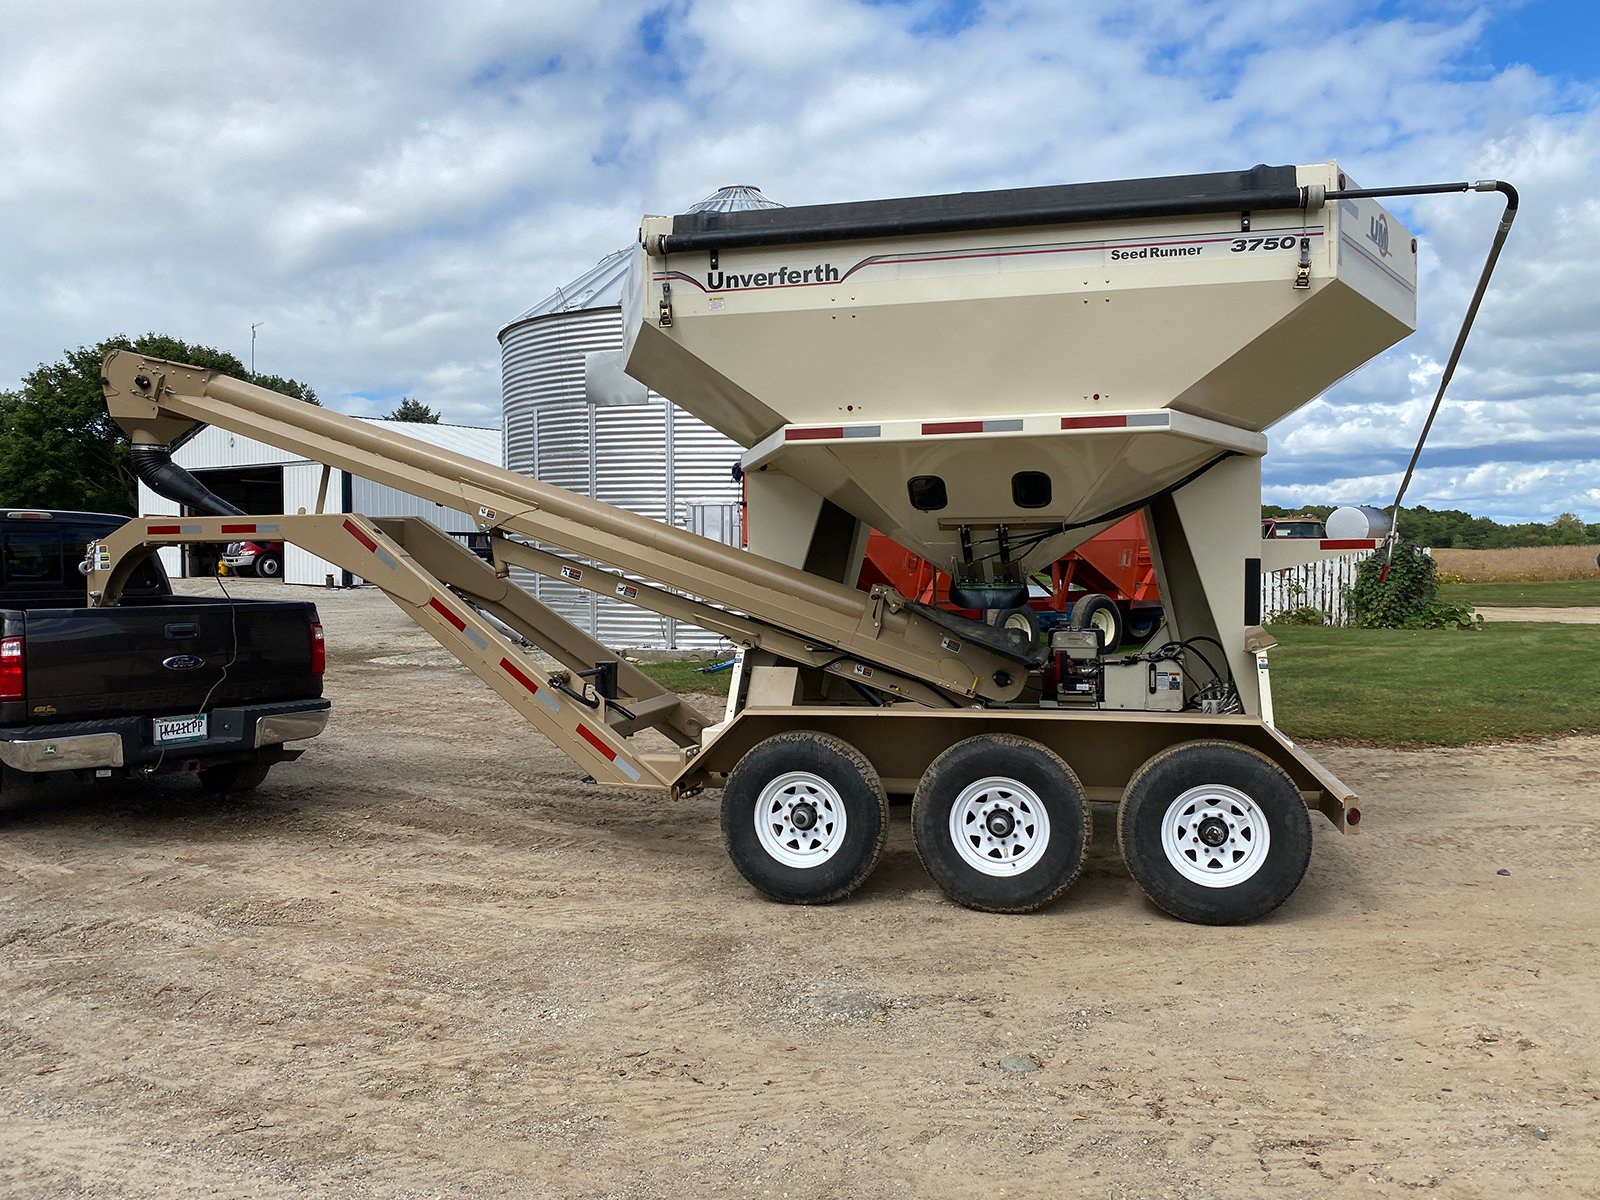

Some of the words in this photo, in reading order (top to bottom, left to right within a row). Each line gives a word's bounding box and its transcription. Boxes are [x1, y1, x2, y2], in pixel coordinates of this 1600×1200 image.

[1111, 248, 1147, 260] Seed
[1150, 245, 1203, 258] Runner
[1230, 236, 1296, 253] 3750
[708, 264, 839, 290] Unverferth
